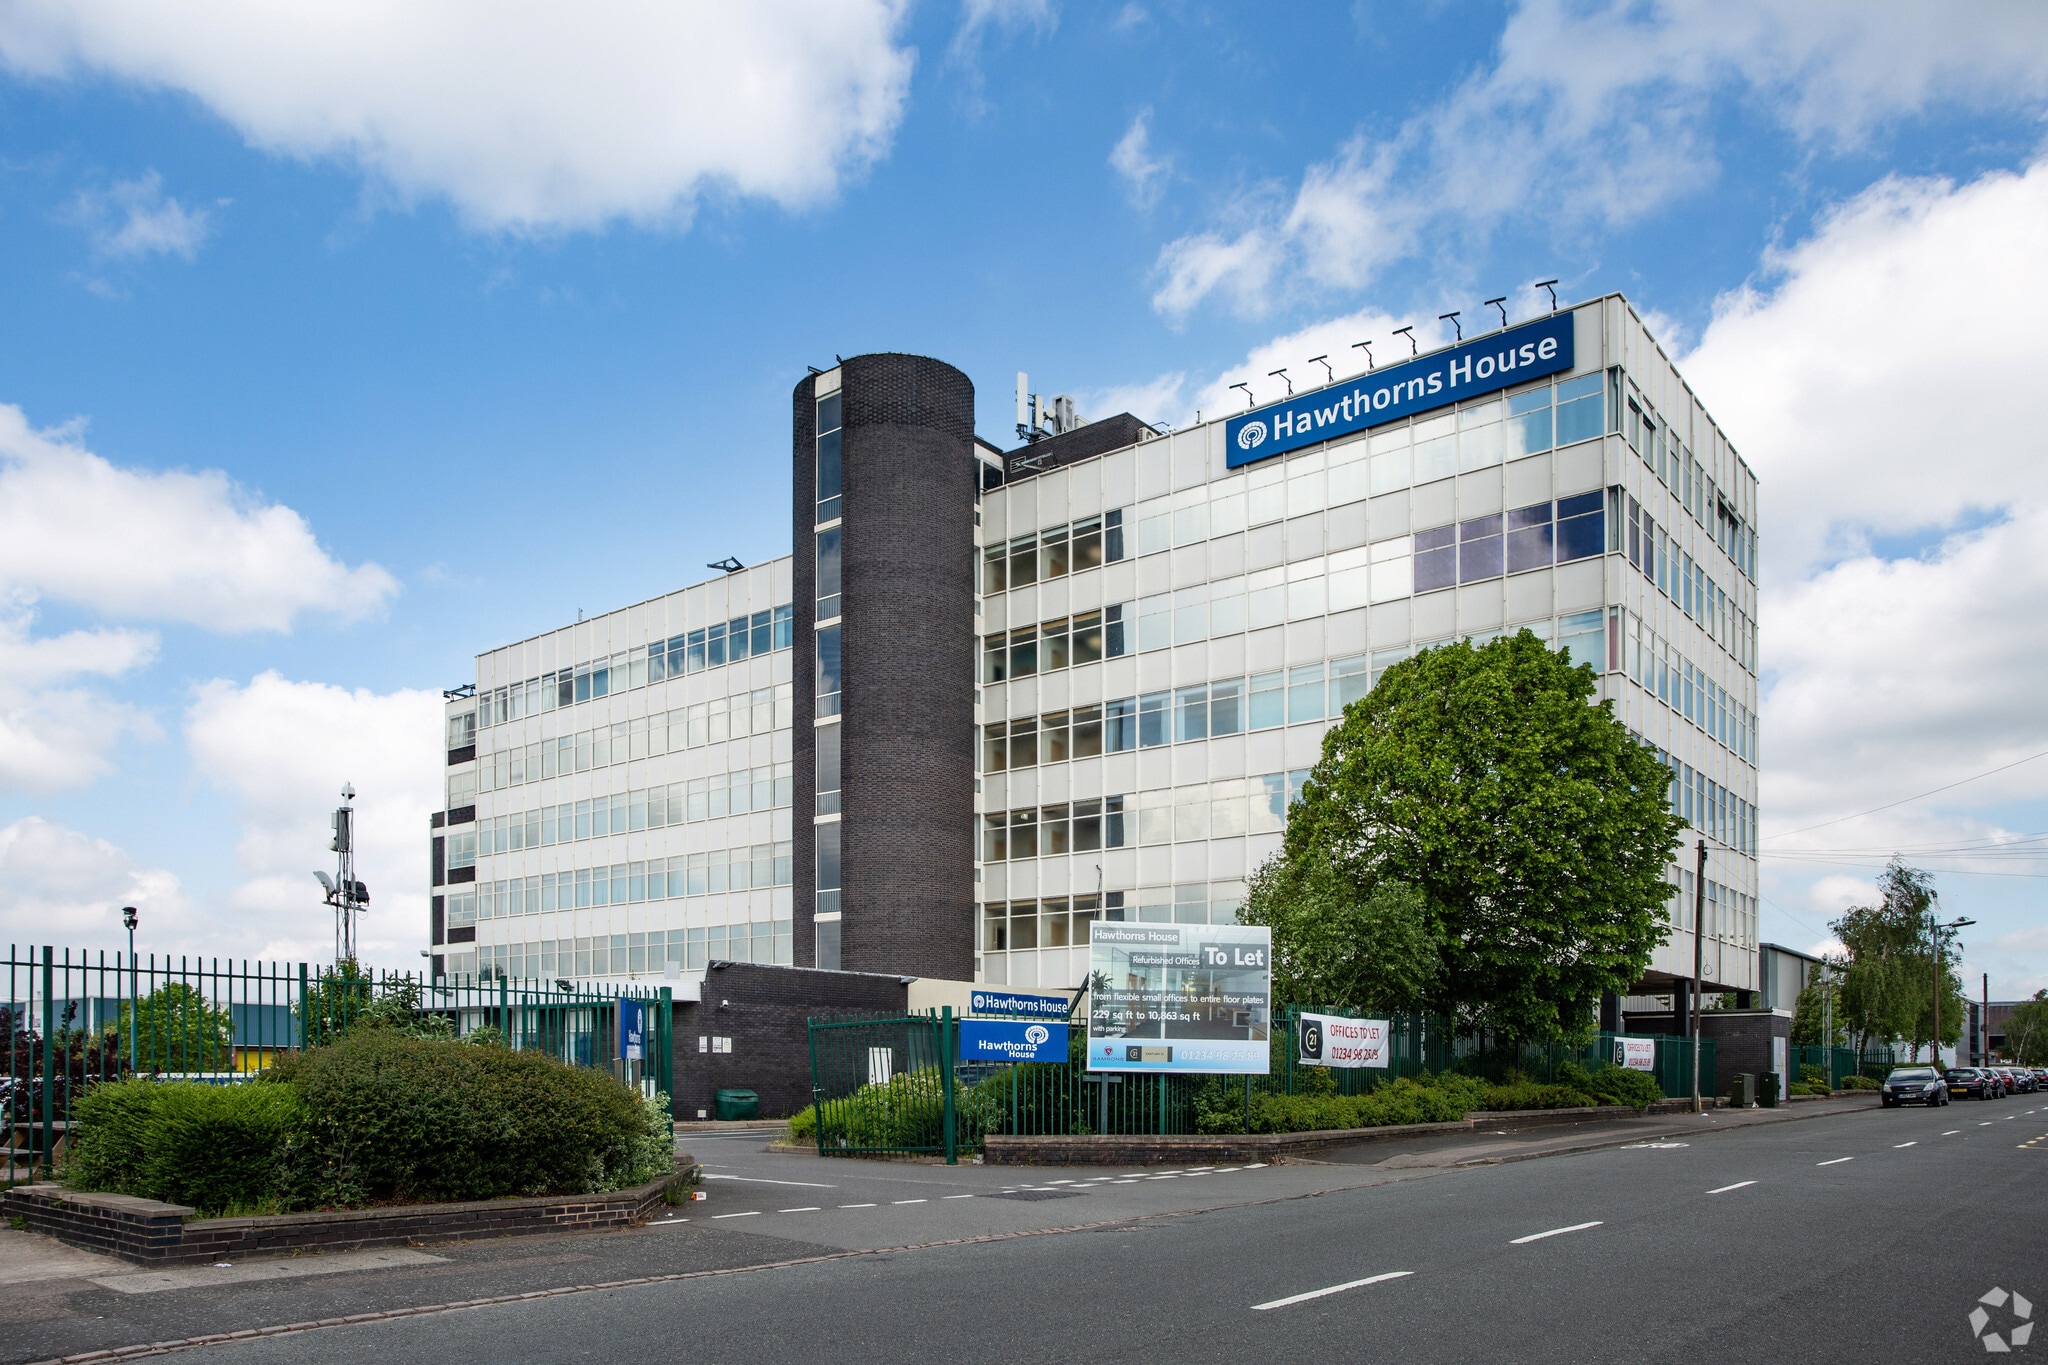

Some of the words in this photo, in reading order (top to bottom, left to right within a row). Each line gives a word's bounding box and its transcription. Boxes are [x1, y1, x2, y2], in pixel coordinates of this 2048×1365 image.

[1273, 370, 1443, 441] Hawthorns
[1450, 336, 1558, 388] House
[1094, 929, 1146, 941] Hawthorns
[1148, 931, 1179, 943] House
[1132, 956, 1174, 965] Refurbished
[1175, 957, 1200, 966] Offices
[1204, 947, 1228, 966] To
[1234, 948, 1264, 967] Let
[986, 995, 1039, 1012] Hawthorns
[1040, 999, 1068, 1014] House
[1094, 992, 1112, 1001] from
[1114, 992, 1140, 1001] flexible
[1142, 993, 1162, 1002] small
[1163, 993, 1188, 1002] offices
[1190, 995, 1198, 1003] to
[1200, 995, 1221, 1003] entire
[1223, 995, 1241, 1004] floor
[1242, 995, 1265, 1005] plates
[1092, 1009, 1110, 1019] 229
[1112, 1012, 1123, 1021] sq
[1125, 1010, 1134, 1020] ft
[1136, 1011, 1146, 1020] to
[1148, 1011, 1178, 1021] 10,863
[1179, 1013, 1190, 1022] sq
[1192, 1012, 1201, 1021] ft
[1330, 1024, 1359, 1039] OFFICES
[978, 1039, 1038, 1051] Hawthorns
[1008, 1050, 1035, 1059] House
[1181, 1050, 1213, 1061] 01234
[1215, 1050, 1229, 1061] 98
[1231, 1050, 1244, 1061] 25
[1247, 1050, 1260, 1061] 89
[1332, 1046, 1352, 1061] 01234
[1353, 1048, 1363, 1061] 98
